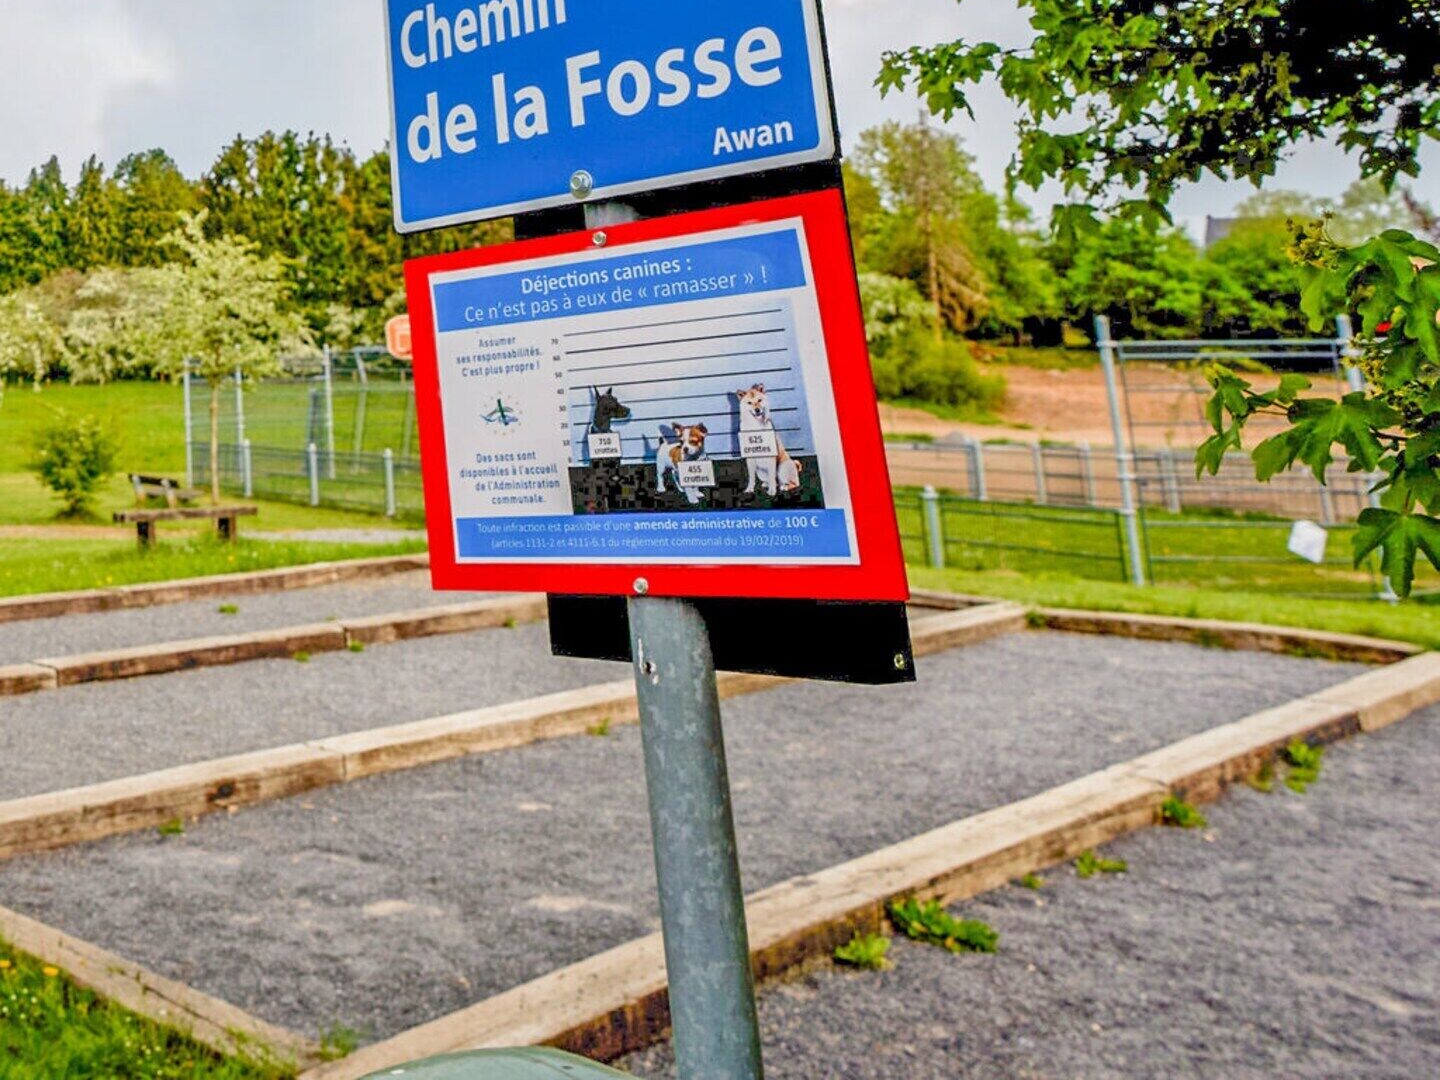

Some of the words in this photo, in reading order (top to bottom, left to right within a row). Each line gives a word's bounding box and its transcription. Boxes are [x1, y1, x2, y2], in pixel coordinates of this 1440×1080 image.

[407, 92, 477, 164] de
[491, 72, 549, 145] la
[565, 25, 783, 128] Fosse
[713, 120, 794, 156] Awan
[521, 268, 609, 295] Déjections
[613, 259, 681, 281] canines
[464, 306, 484, 322] Ce
[531, 299, 558, 318] pas
[563, 293, 572, 310] à
[577, 292, 607, 307] eux
[612, 286, 633, 303] de
[654, 272, 737, 298] ramasser
[456, 356, 471, 364] ses
[485, 365, 503, 377] plus
[505, 362, 535, 374] propre
[744, 443, 771, 453] crottes
[476, 453, 492, 463] Des
[495, 453, 514, 462] sacs
[517, 451, 536, 460] sont
[460, 467, 509, 478] disponibles
[683, 474, 710, 483] crottes
[475, 481, 485, 491] de
[477, 522, 500, 533] Toute
[503, 522, 546, 533] infraction
[548, 524, 561, 532] est
[563, 521, 601, 533] passible
[634, 518, 678, 530] amende
[681, 516, 765, 530] administrative
[768, 517, 782, 528] de
[785, 516, 808, 528] 100
[811, 515, 819, 528] €
[608, 538, 620, 547] du
[671, 535, 722, 547] communal
[724, 535, 737, 546] du
[741, 534, 804, 547] 19/02/2019)
